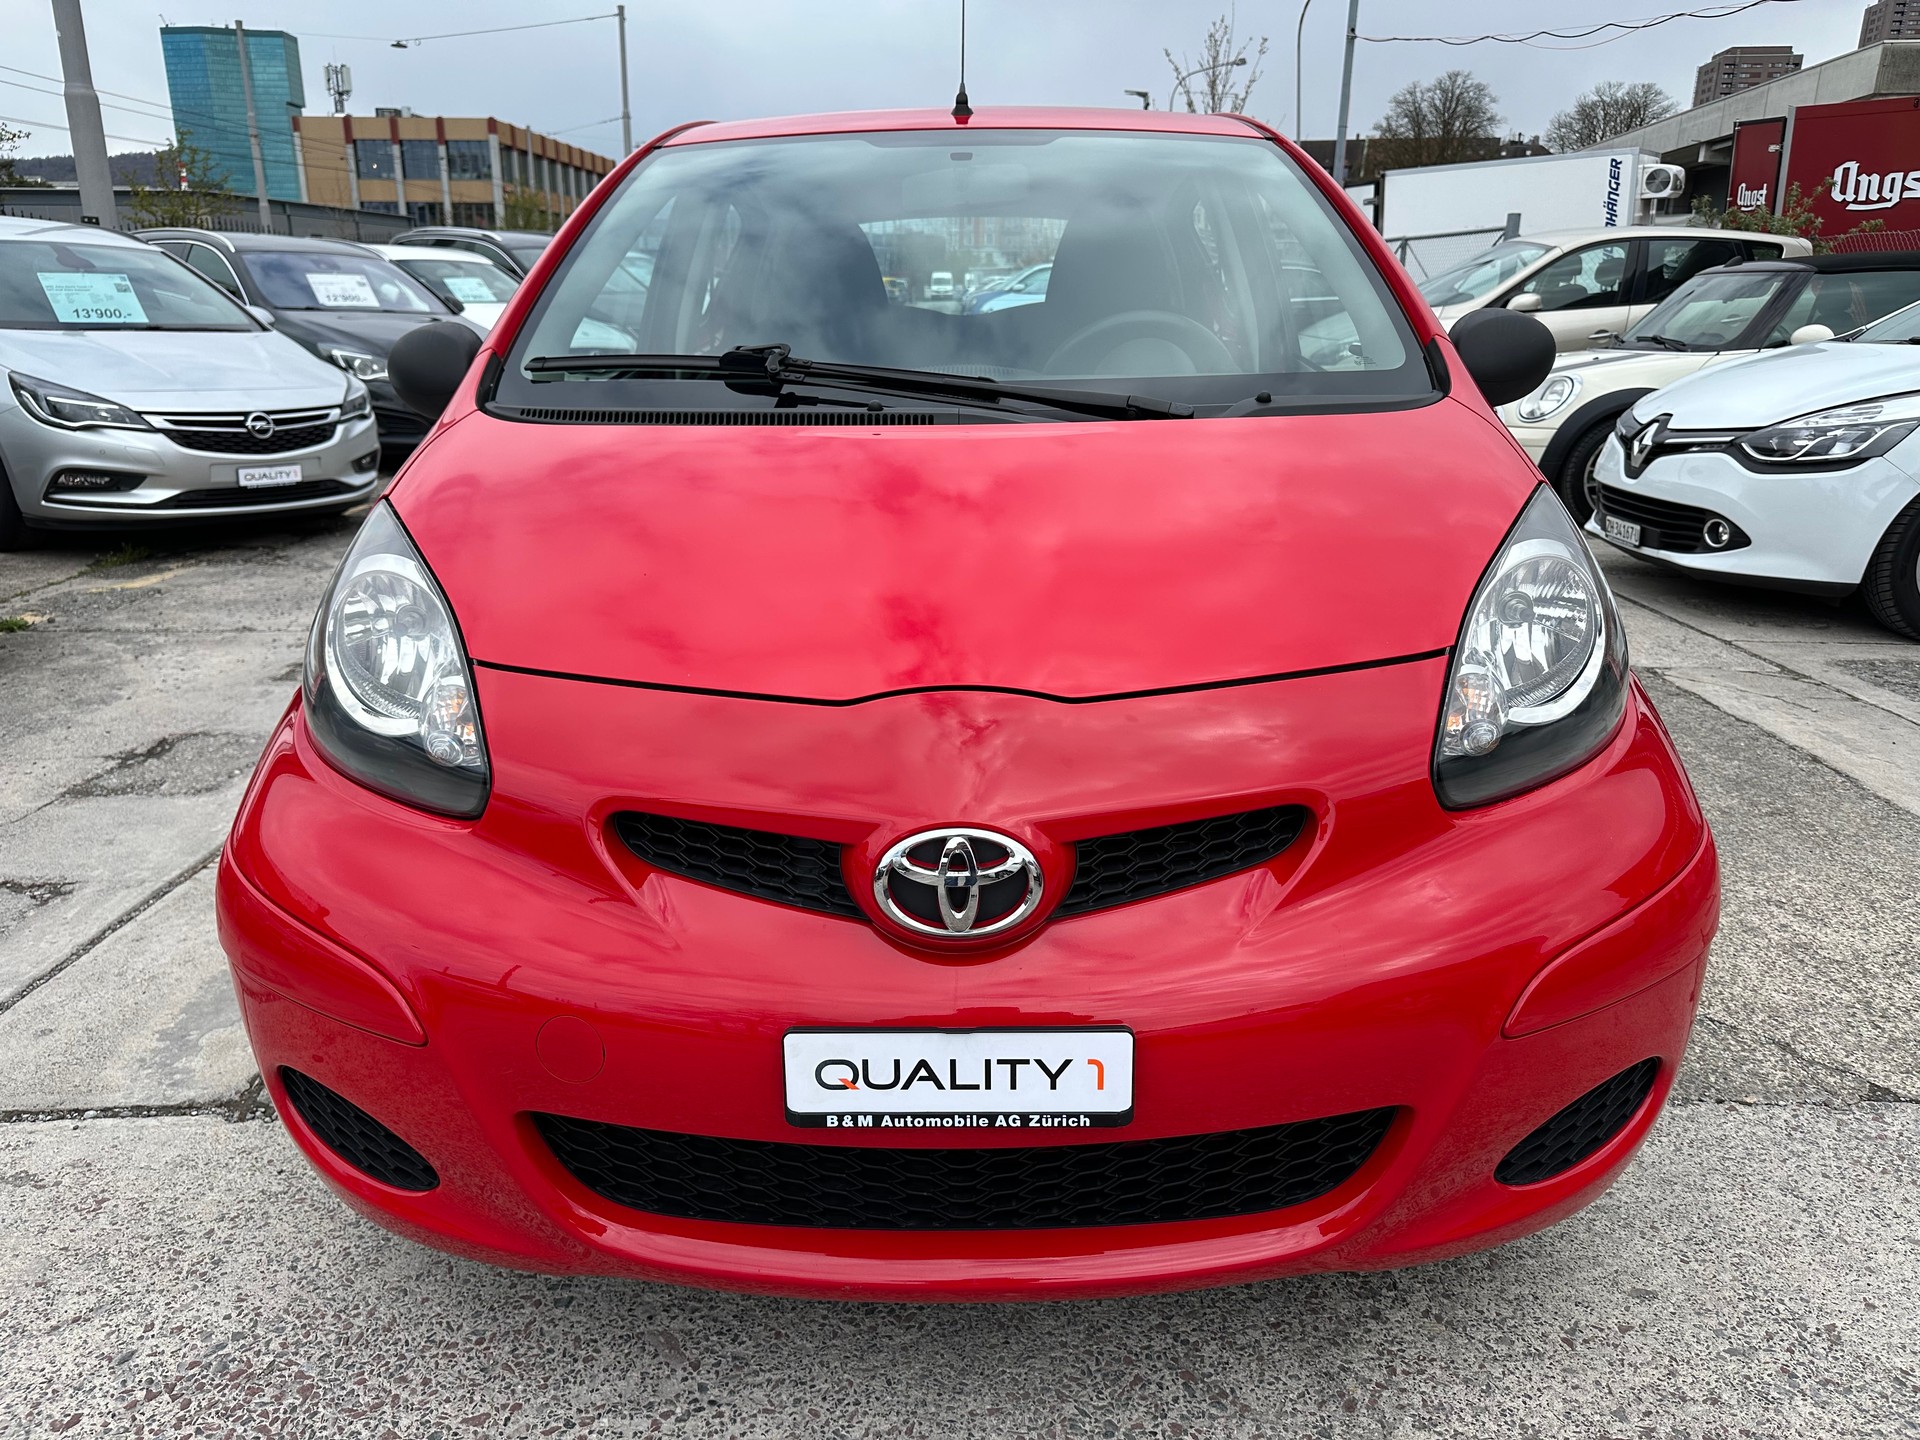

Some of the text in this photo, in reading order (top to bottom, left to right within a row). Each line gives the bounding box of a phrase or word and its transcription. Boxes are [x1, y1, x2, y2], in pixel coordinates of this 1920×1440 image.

[1737, 182, 1767, 211] Angst
[72, 308, 132, 319] 13'900.-
[244, 470, 292, 482] QUALITY
[814, 1058, 1105, 1091] QUALITY 1
[880, 1114, 989, 1128] Automobile
[995, 1114, 1022, 1128] AG
[1028, 1114, 1091, 1128] Zürich
